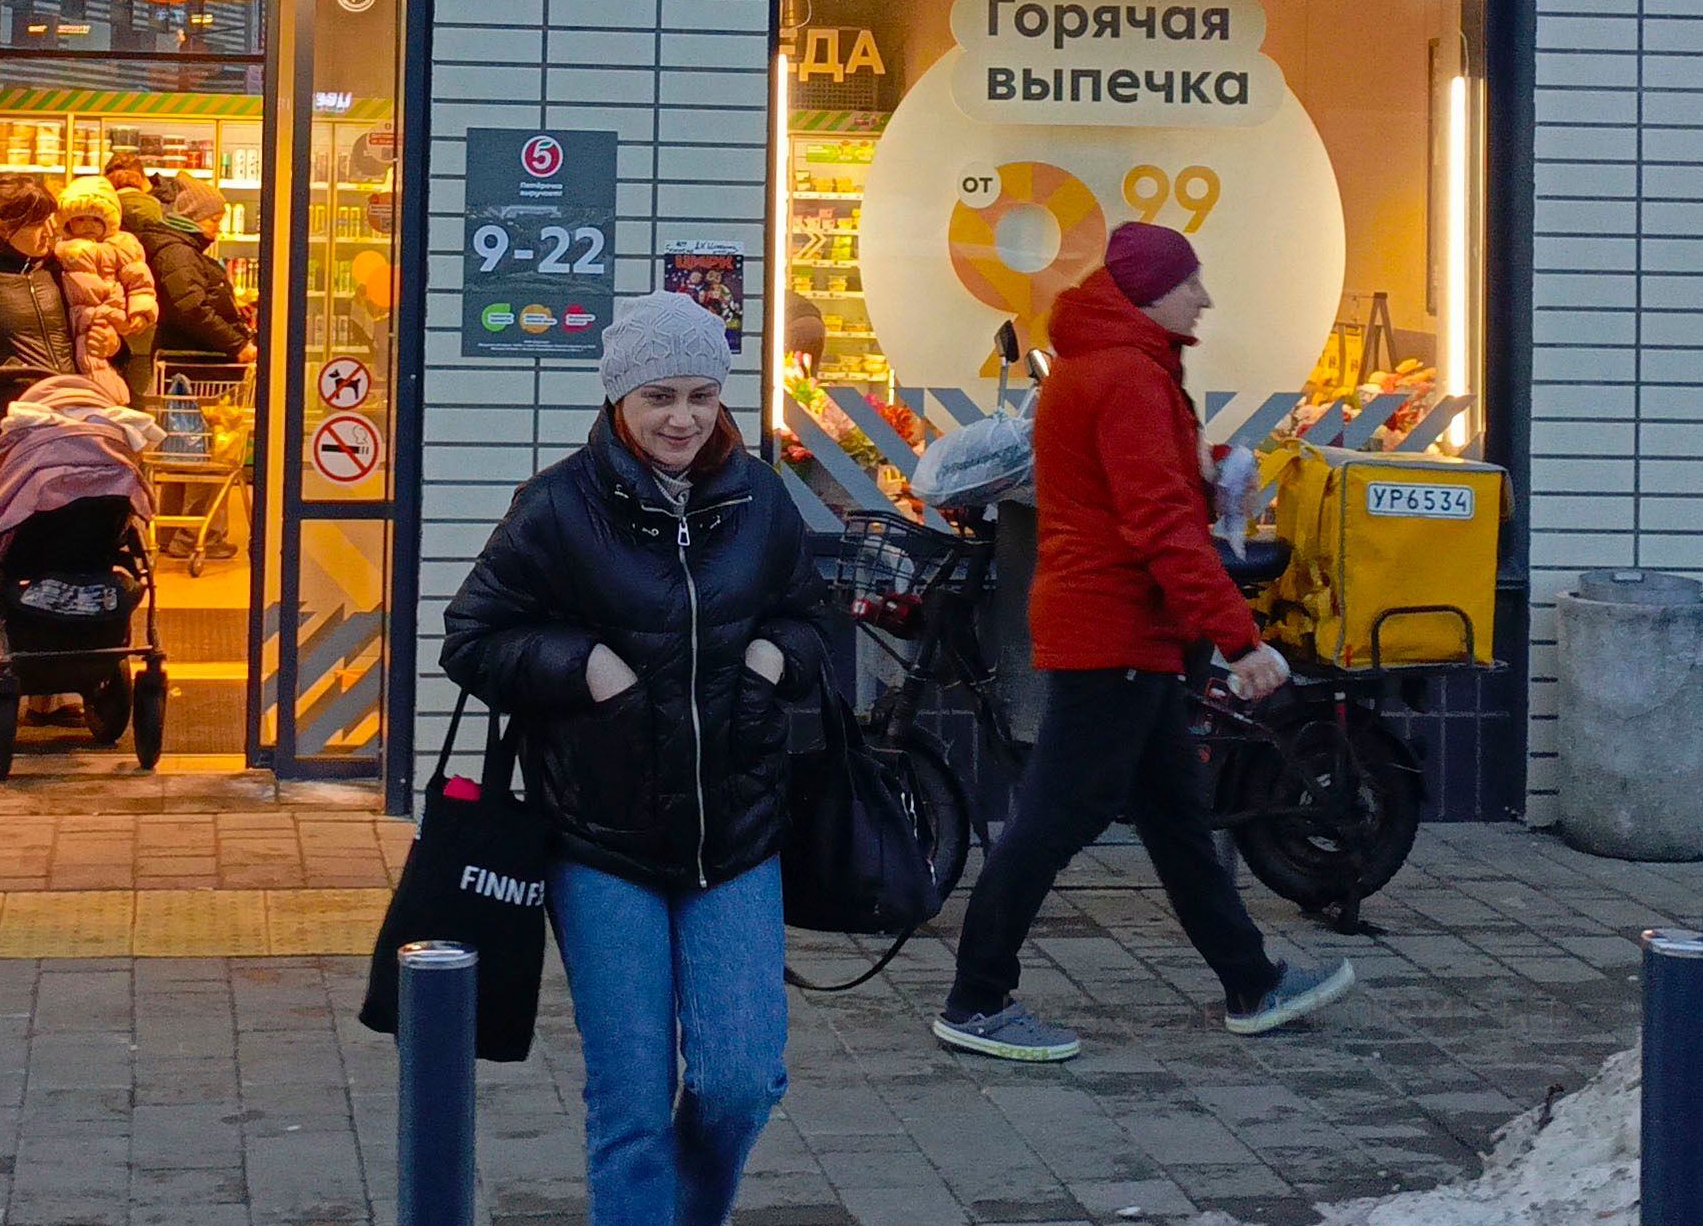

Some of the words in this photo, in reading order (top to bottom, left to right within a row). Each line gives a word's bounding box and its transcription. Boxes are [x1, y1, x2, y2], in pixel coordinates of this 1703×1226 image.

[987, 66, 1249, 105] выпечка
[1123, 165, 1222, 234] 99
[473, 224, 605, 274] 9-22
[1374, 488, 1468, 513] УР6534
[460, 865, 526, 905] FINN
